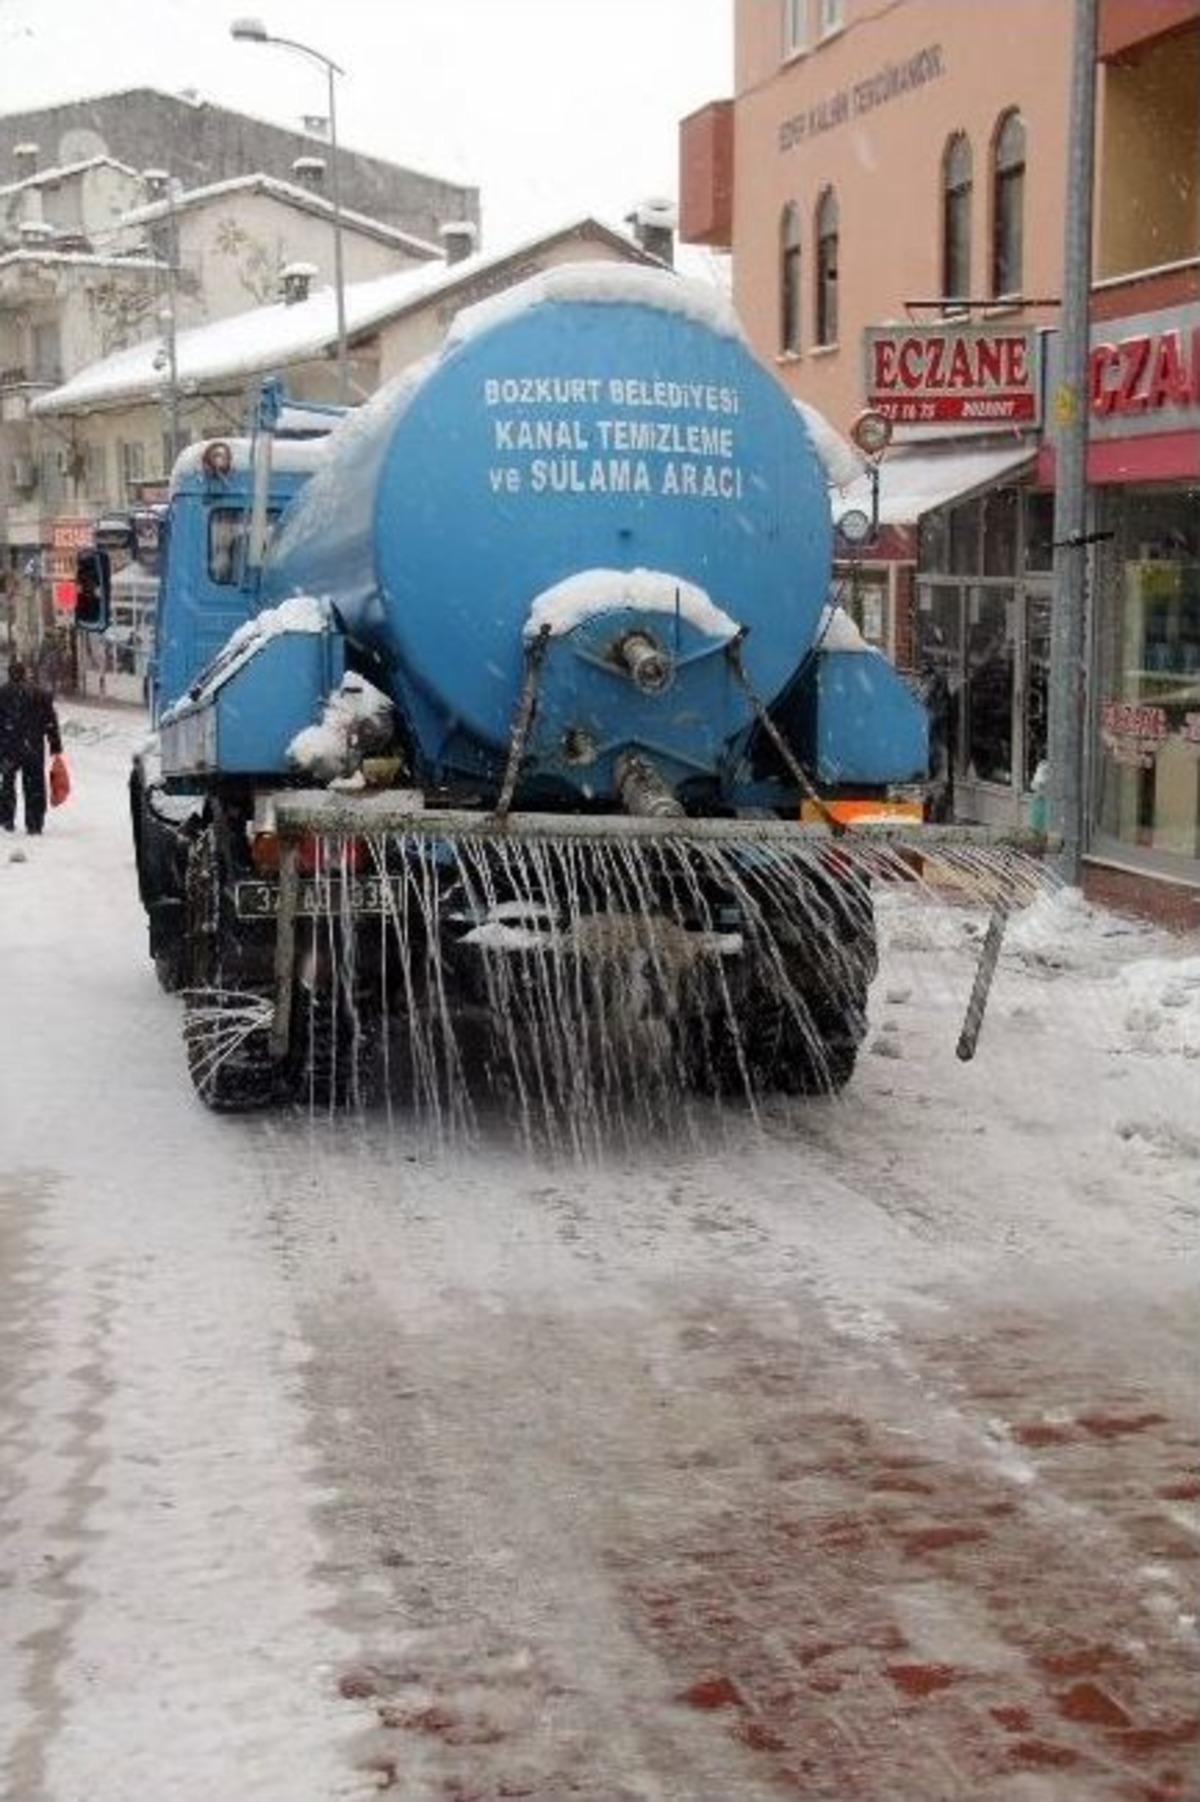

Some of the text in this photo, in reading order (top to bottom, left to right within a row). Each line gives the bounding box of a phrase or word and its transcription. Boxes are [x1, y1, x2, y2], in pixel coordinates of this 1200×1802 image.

[874, 337, 1029, 389] ECZANE
[484, 378, 601, 406] BOZKURT
[495, 420, 589, 451] KANAL
[489, 458, 742, 500] ve SULAMA ARACI
